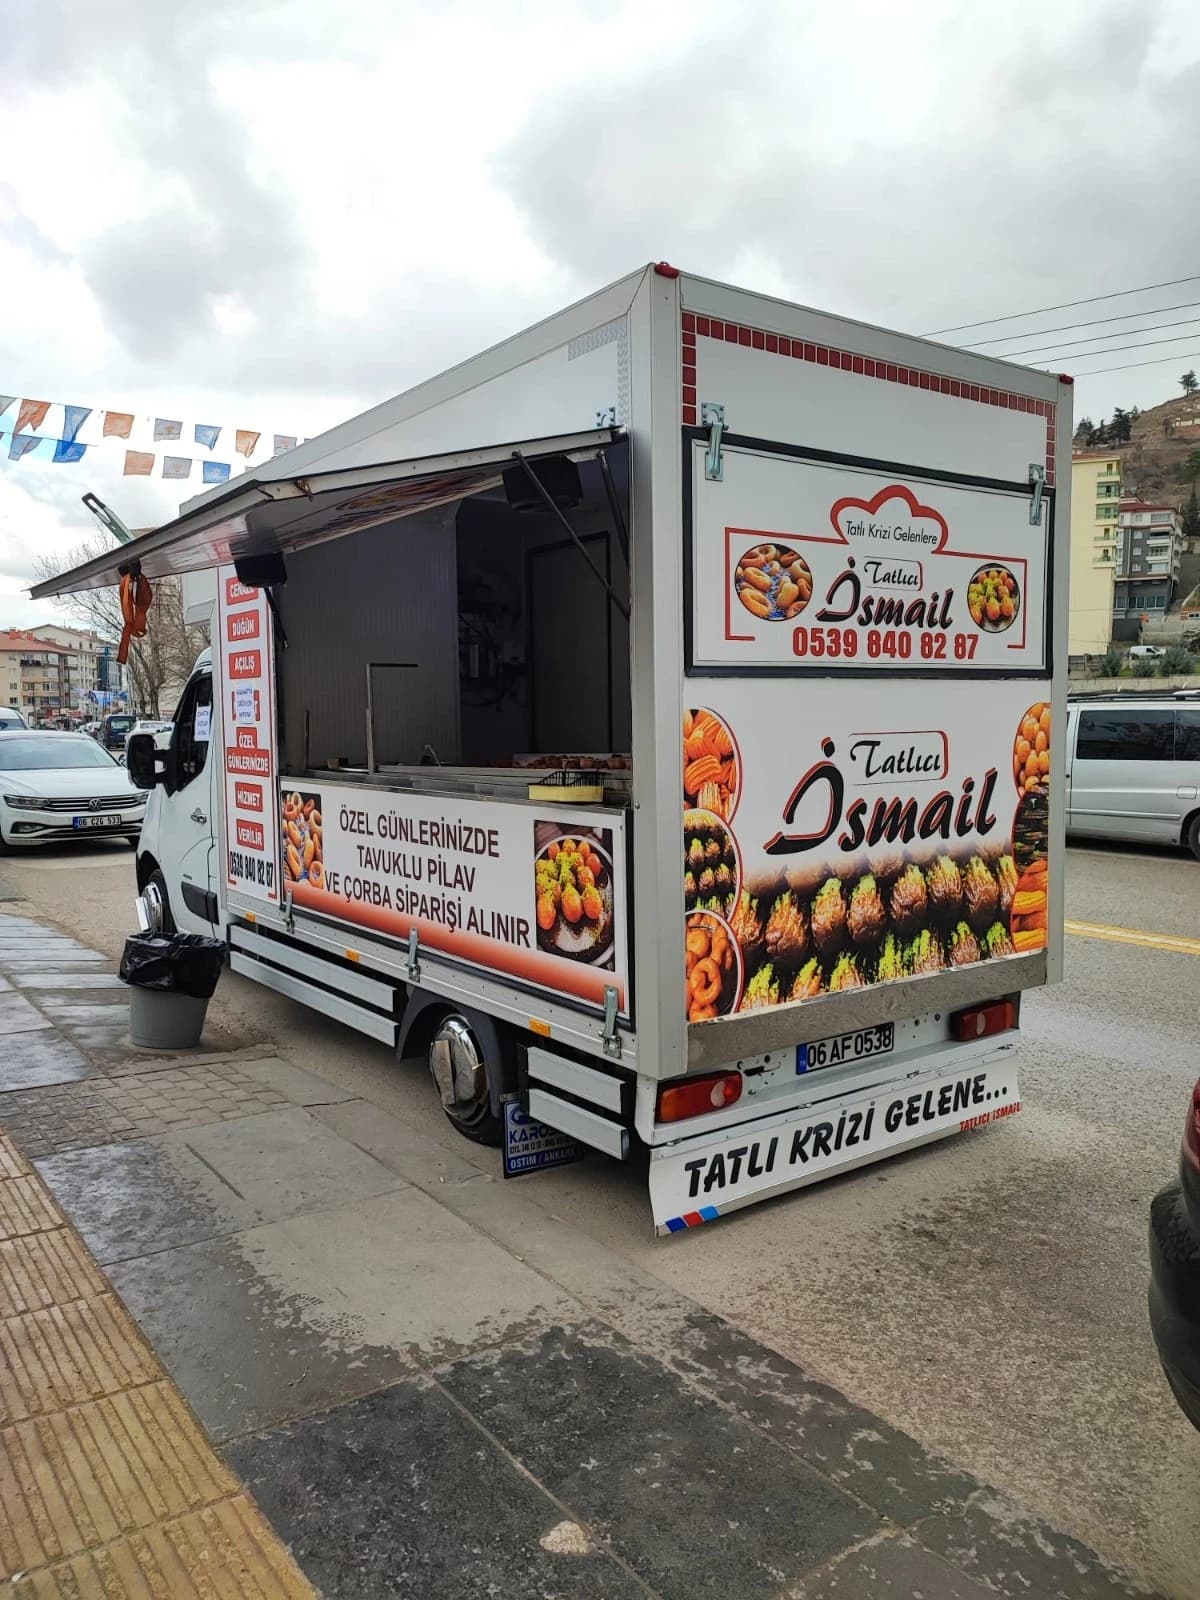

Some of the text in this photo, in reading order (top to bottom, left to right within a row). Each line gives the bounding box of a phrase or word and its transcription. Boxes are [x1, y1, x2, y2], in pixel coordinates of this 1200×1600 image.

[846, 520, 938, 545] Tatlı Krizi Gelenlere
[863, 560, 919, 586] Tatlıcı
[232, 616, 255, 637] DÜĞÜN
[792, 626, 979, 660] 0539 840 82 87
[234, 655, 255, 674] AÇILIŞ
[239, 731, 256, 749] ÖZEL
[227, 752, 269, 773] GÜNLERİNİZDE
[850, 739, 942, 779] Tatlıcı
[340, 804, 500, 858] ÖZEL GÜNLERİNİZDE
[229, 851, 274, 888] 0539 840 82 87
[356, 844, 477, 893] TAVUKLU PİLAV
[324, 870, 531, 948] VE ÇORBA SİPARİŞİ ALINIR
[807, 1028, 892, 1068] 06 AF 0538
[684, 1073, 1008, 1197] TATLI KRİZİ GELENE...
[959, 1111, 991, 1132] TATLICI
